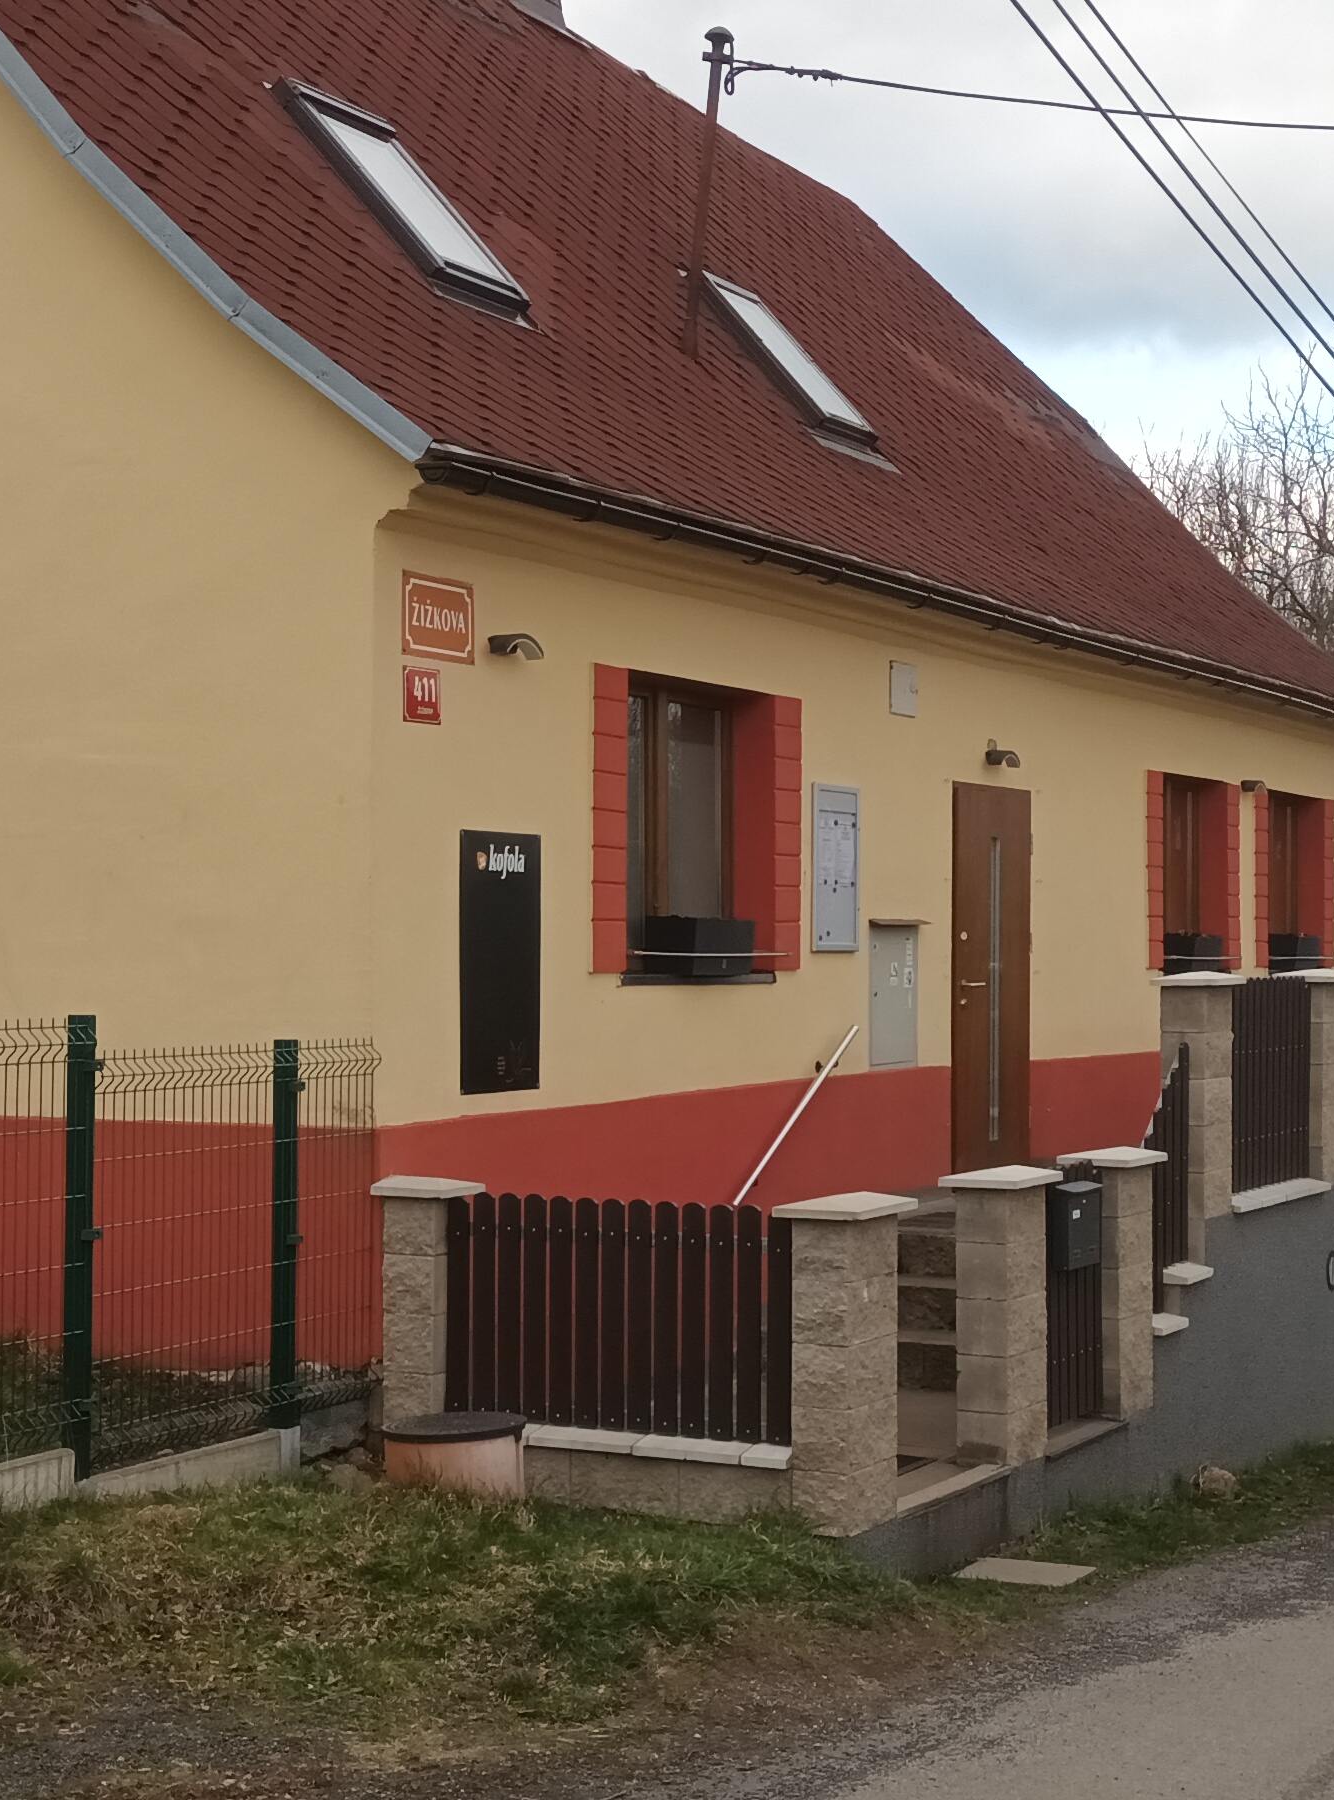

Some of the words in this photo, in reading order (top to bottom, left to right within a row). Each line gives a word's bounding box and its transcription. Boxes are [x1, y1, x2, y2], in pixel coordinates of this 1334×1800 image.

[411, 596, 466, 634] ŽIŽKOVA
[413, 675, 436, 703] 411
[488, 844, 525, 880] kofola
